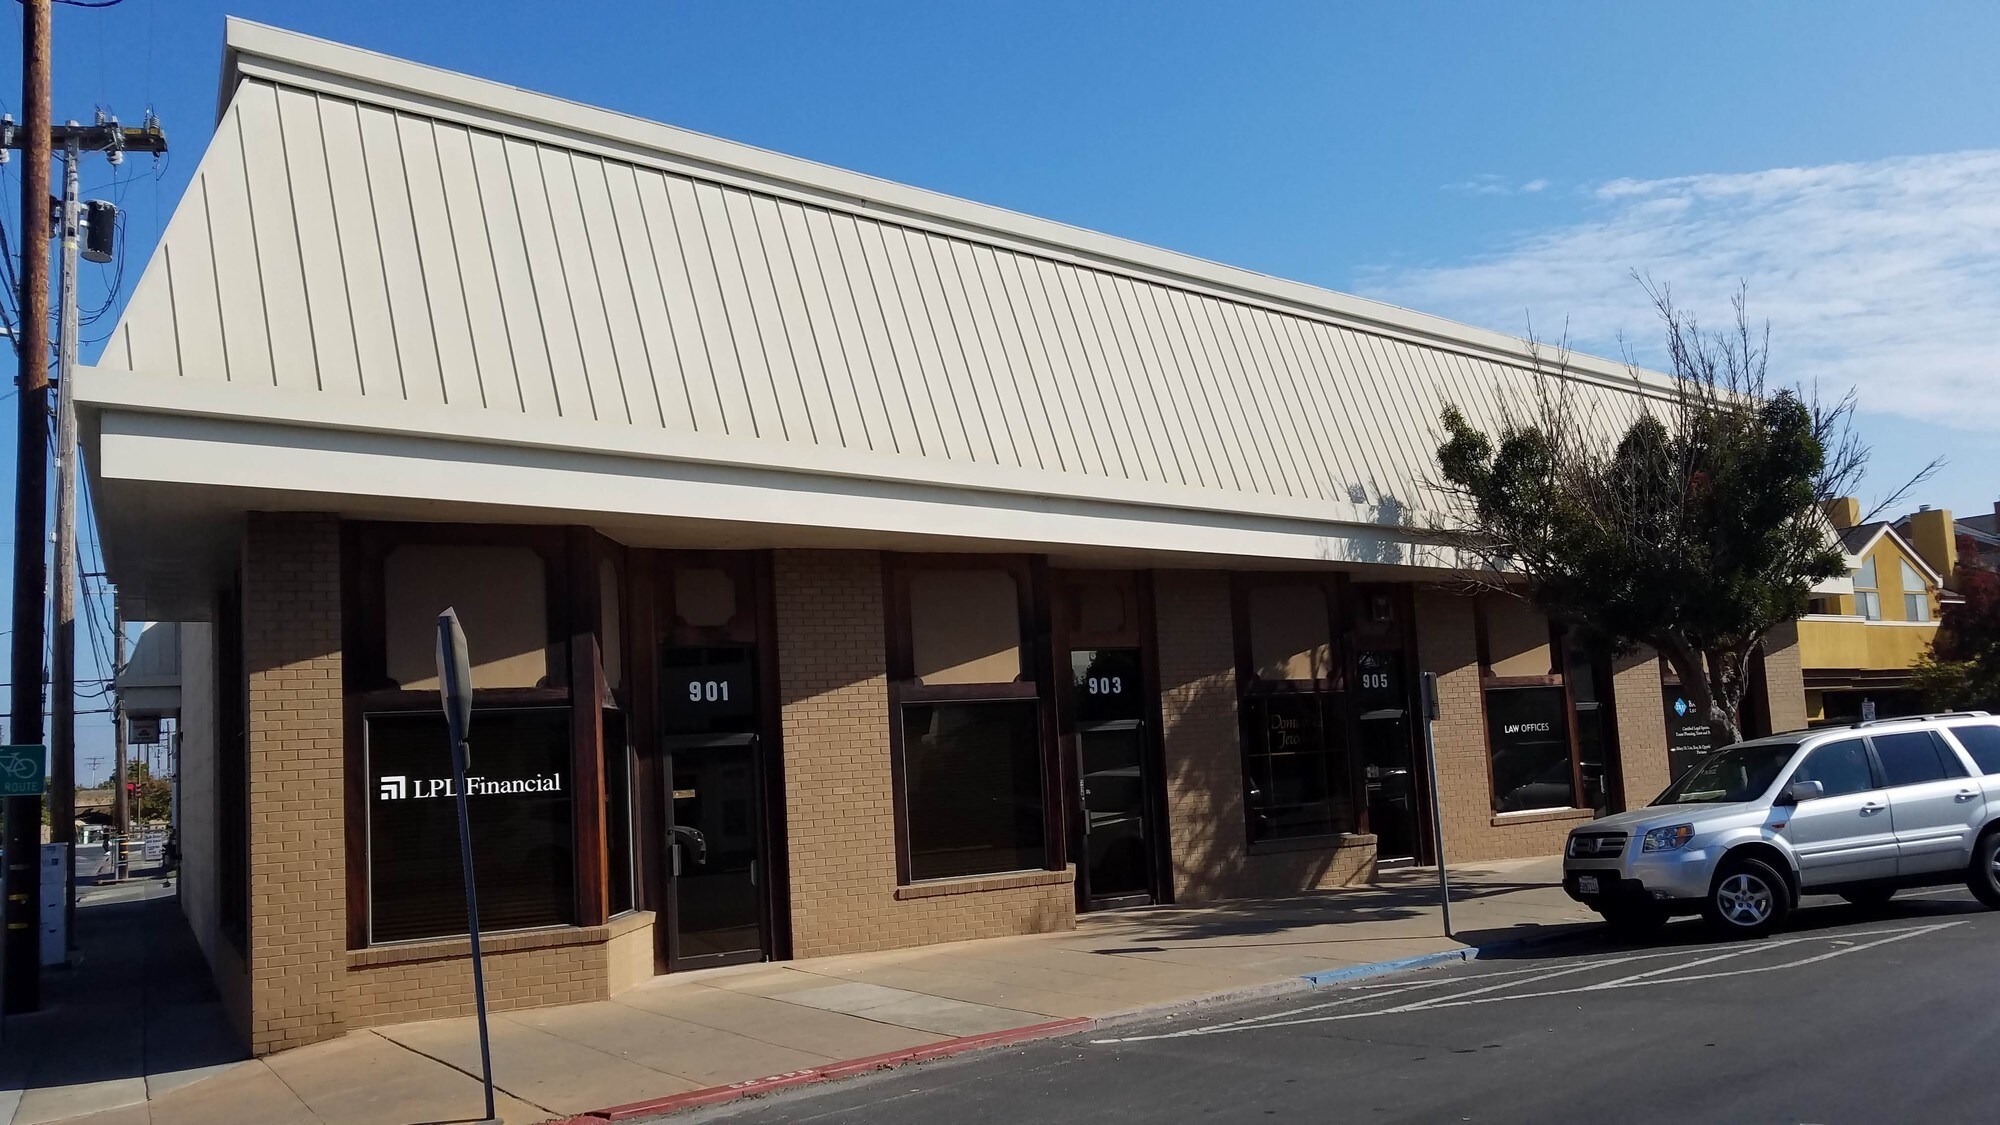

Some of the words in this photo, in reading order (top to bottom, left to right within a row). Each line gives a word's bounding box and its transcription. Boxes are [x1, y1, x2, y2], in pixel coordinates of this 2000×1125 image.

[1088, 677, 1121, 694] 903
[1363, 674, 1388, 688] 905
[689, 681, 729, 701] 901
[1504, 724, 1519, 733] LAW
[1521, 722, 1549, 732] OFFICES
[4, 782, 39, 792] ROUTE
[413, 779, 457, 798] LPL
[465, 773, 561, 796] Financial
